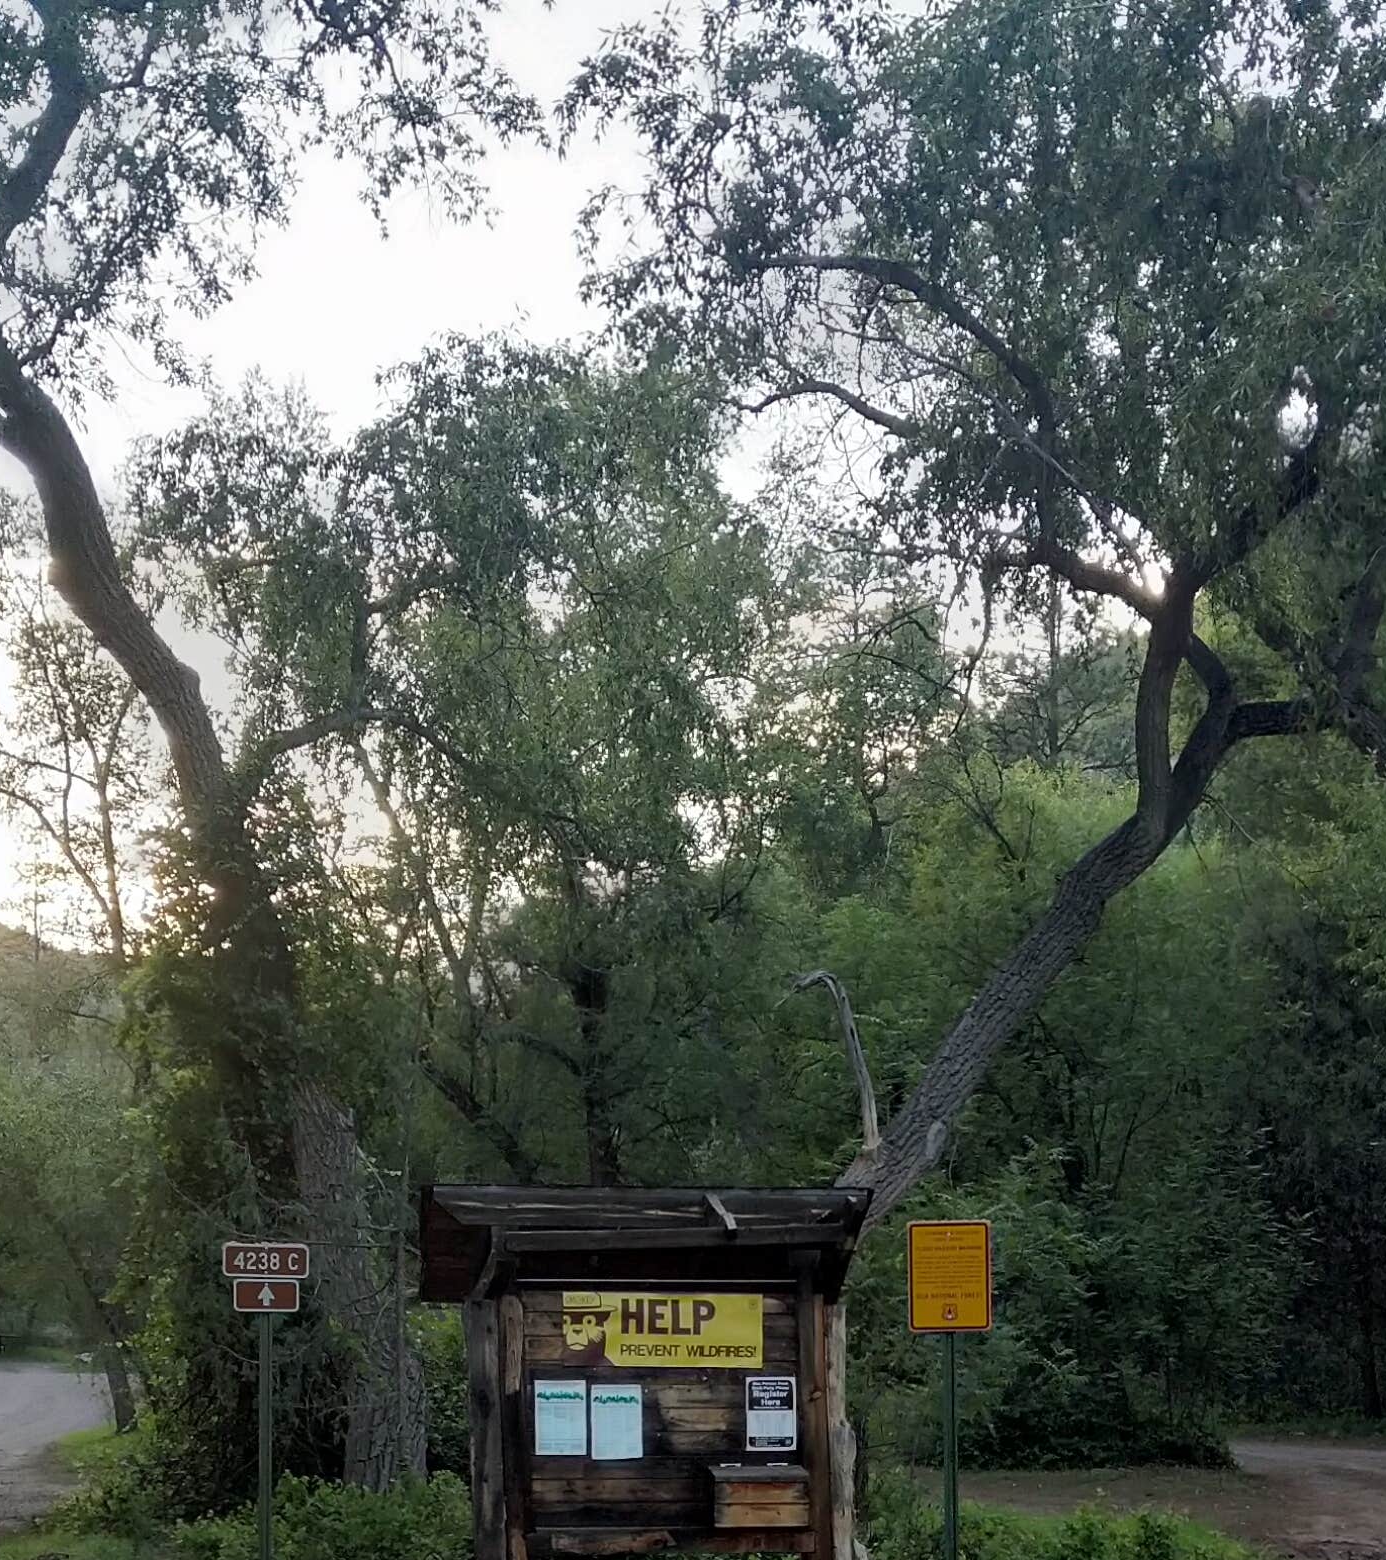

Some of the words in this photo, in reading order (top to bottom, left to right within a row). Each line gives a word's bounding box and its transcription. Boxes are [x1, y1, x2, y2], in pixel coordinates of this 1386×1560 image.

[233, 1251, 280, 1270] 4238
[288, 1252, 299, 1271] C
[620, 1298, 716, 1335] HELP
[620, 1344, 681, 1357] PREVENT
[686, 1344, 757, 1358] WILDFIRES!
[753, 1390, 788, 1399] Register
